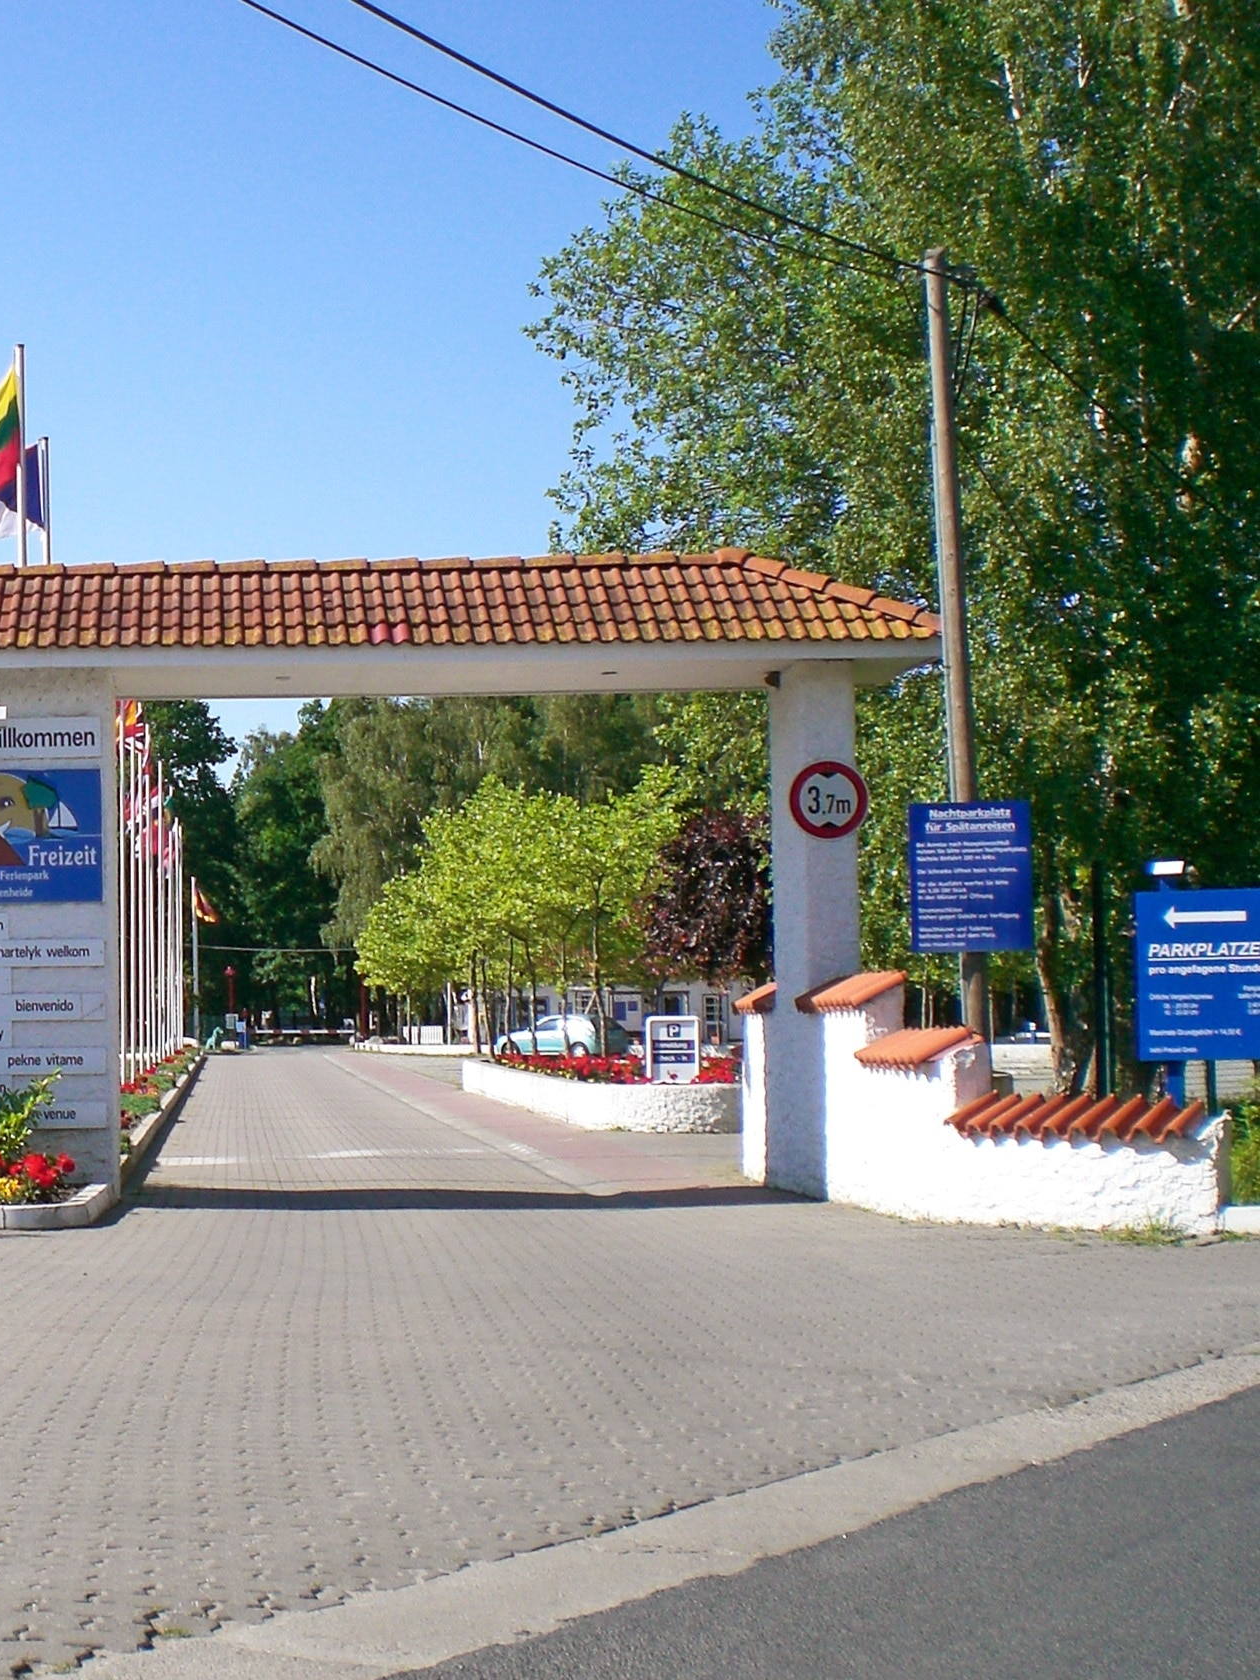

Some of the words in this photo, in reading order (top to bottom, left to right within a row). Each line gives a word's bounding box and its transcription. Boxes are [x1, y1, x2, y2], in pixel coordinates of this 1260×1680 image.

[928, 807, 1011, 818] Nachtparkplatz
[925, 822, 942, 830] für
[28, 845, 97, 866] Freizeit
[0, 870, 49, 881] Ferienpark
[46, 946, 90, 958] welkom
[1148, 967, 1166, 976] pro
[1228, 963, 1260, 973] Stund
[15, 1000, 74, 1012] bienvenido
[7, 1053, 42, 1068] pekne
[46, 1053, 84, 1065] vitame
